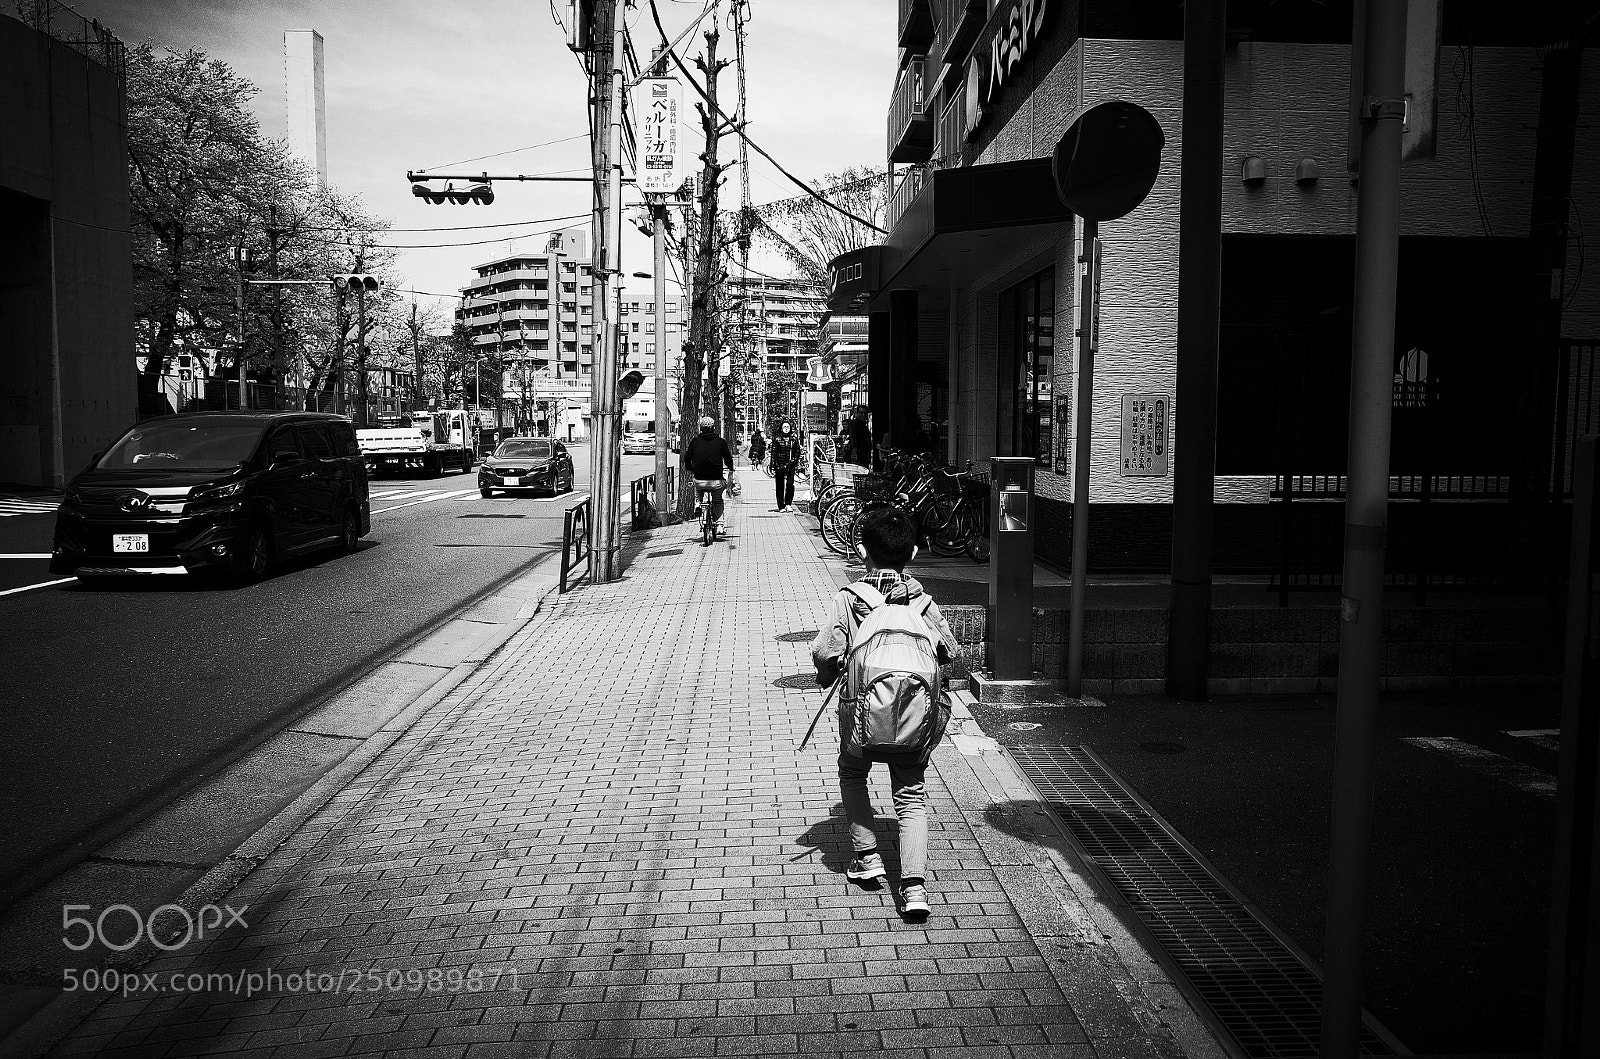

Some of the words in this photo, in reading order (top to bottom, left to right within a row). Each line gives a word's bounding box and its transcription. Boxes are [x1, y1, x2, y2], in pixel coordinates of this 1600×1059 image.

[644, 116, 652, 153] クリニック
[652, 98, 667, 153] ベルーガ
